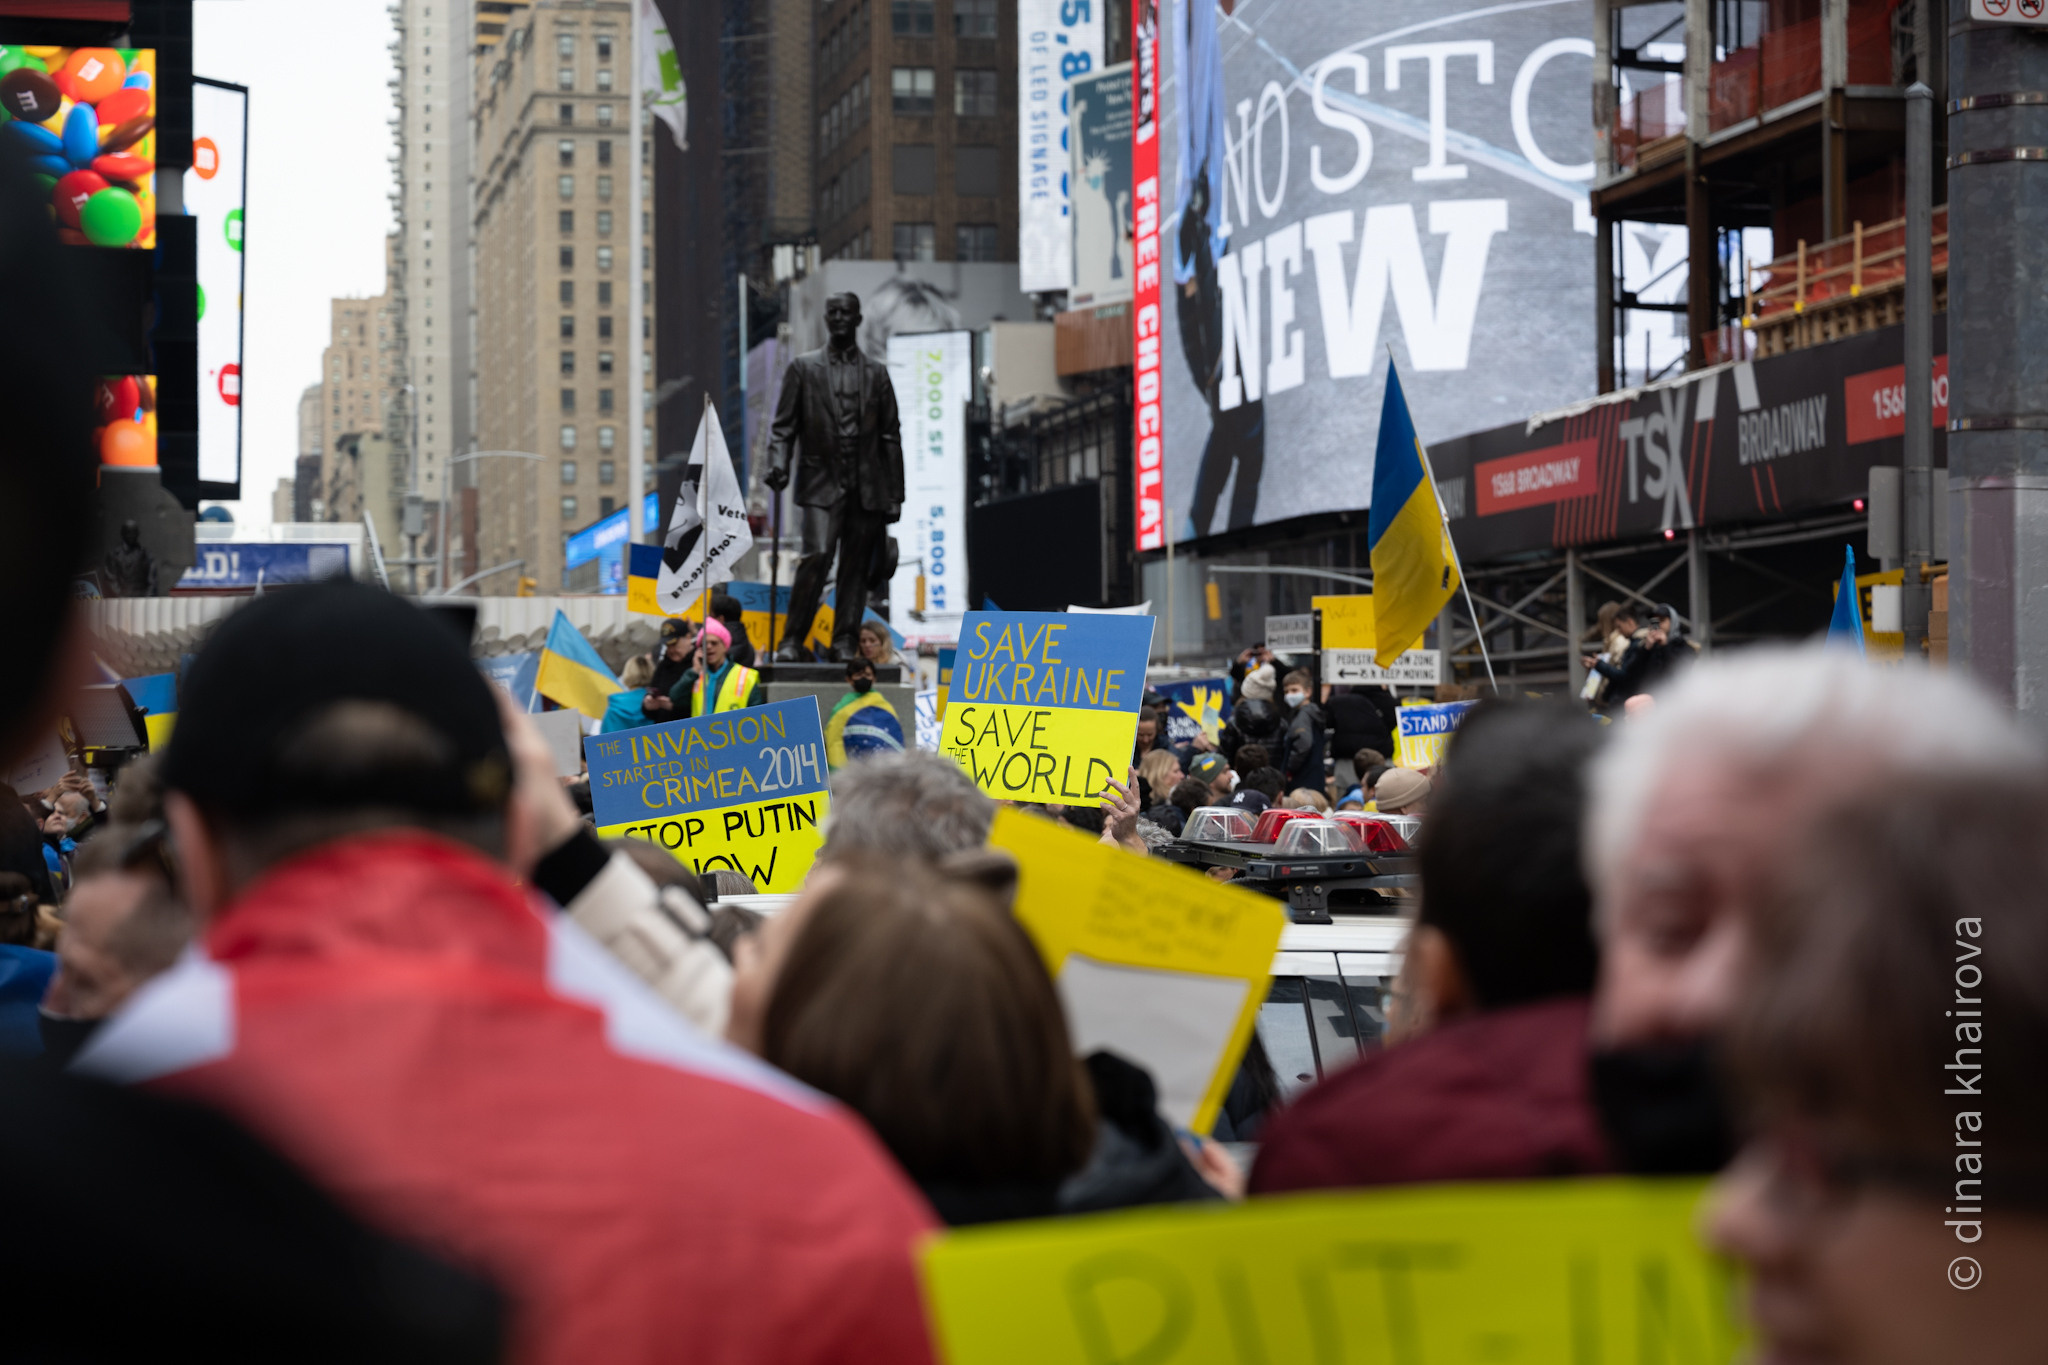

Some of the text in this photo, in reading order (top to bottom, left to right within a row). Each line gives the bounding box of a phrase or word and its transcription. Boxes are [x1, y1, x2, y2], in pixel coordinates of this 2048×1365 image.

[1030, 31, 1048, 200] OF LED SIGNAGE
[1217, 80, 1290, 239] NO
[1217, 199, 1508, 412] NEW
[1137, 177, 1162, 549] FREE CHOCOLAT
[928, 350, 943, 457] 7,000 SF
[1737, 394, 1827, 466] BROADWAY
[1517, 457, 1581, 493] BROADWAY
[1619, 388, 1694, 530] TSX
[929, 506, 945, 609] 5,800 SF
[968, 622, 1067, 664] SAVE
[1413, 654, 1434, 666] ZONE
[963, 663, 1126, 708] UKRAINE
[1380, 668, 1434, 680] KEEP MOVING
[596, 711, 786, 765] THE INVASION
[955, 707, 1051, 750] SAVE
[1400, 713, 1448, 733] STAND
[602, 755, 710, 788] STARTED IN
[641, 742, 822, 809] CRIMEA 2014
[947, 747, 1114, 799] THE WORLD
[723, 800, 818, 841] PUTIN
